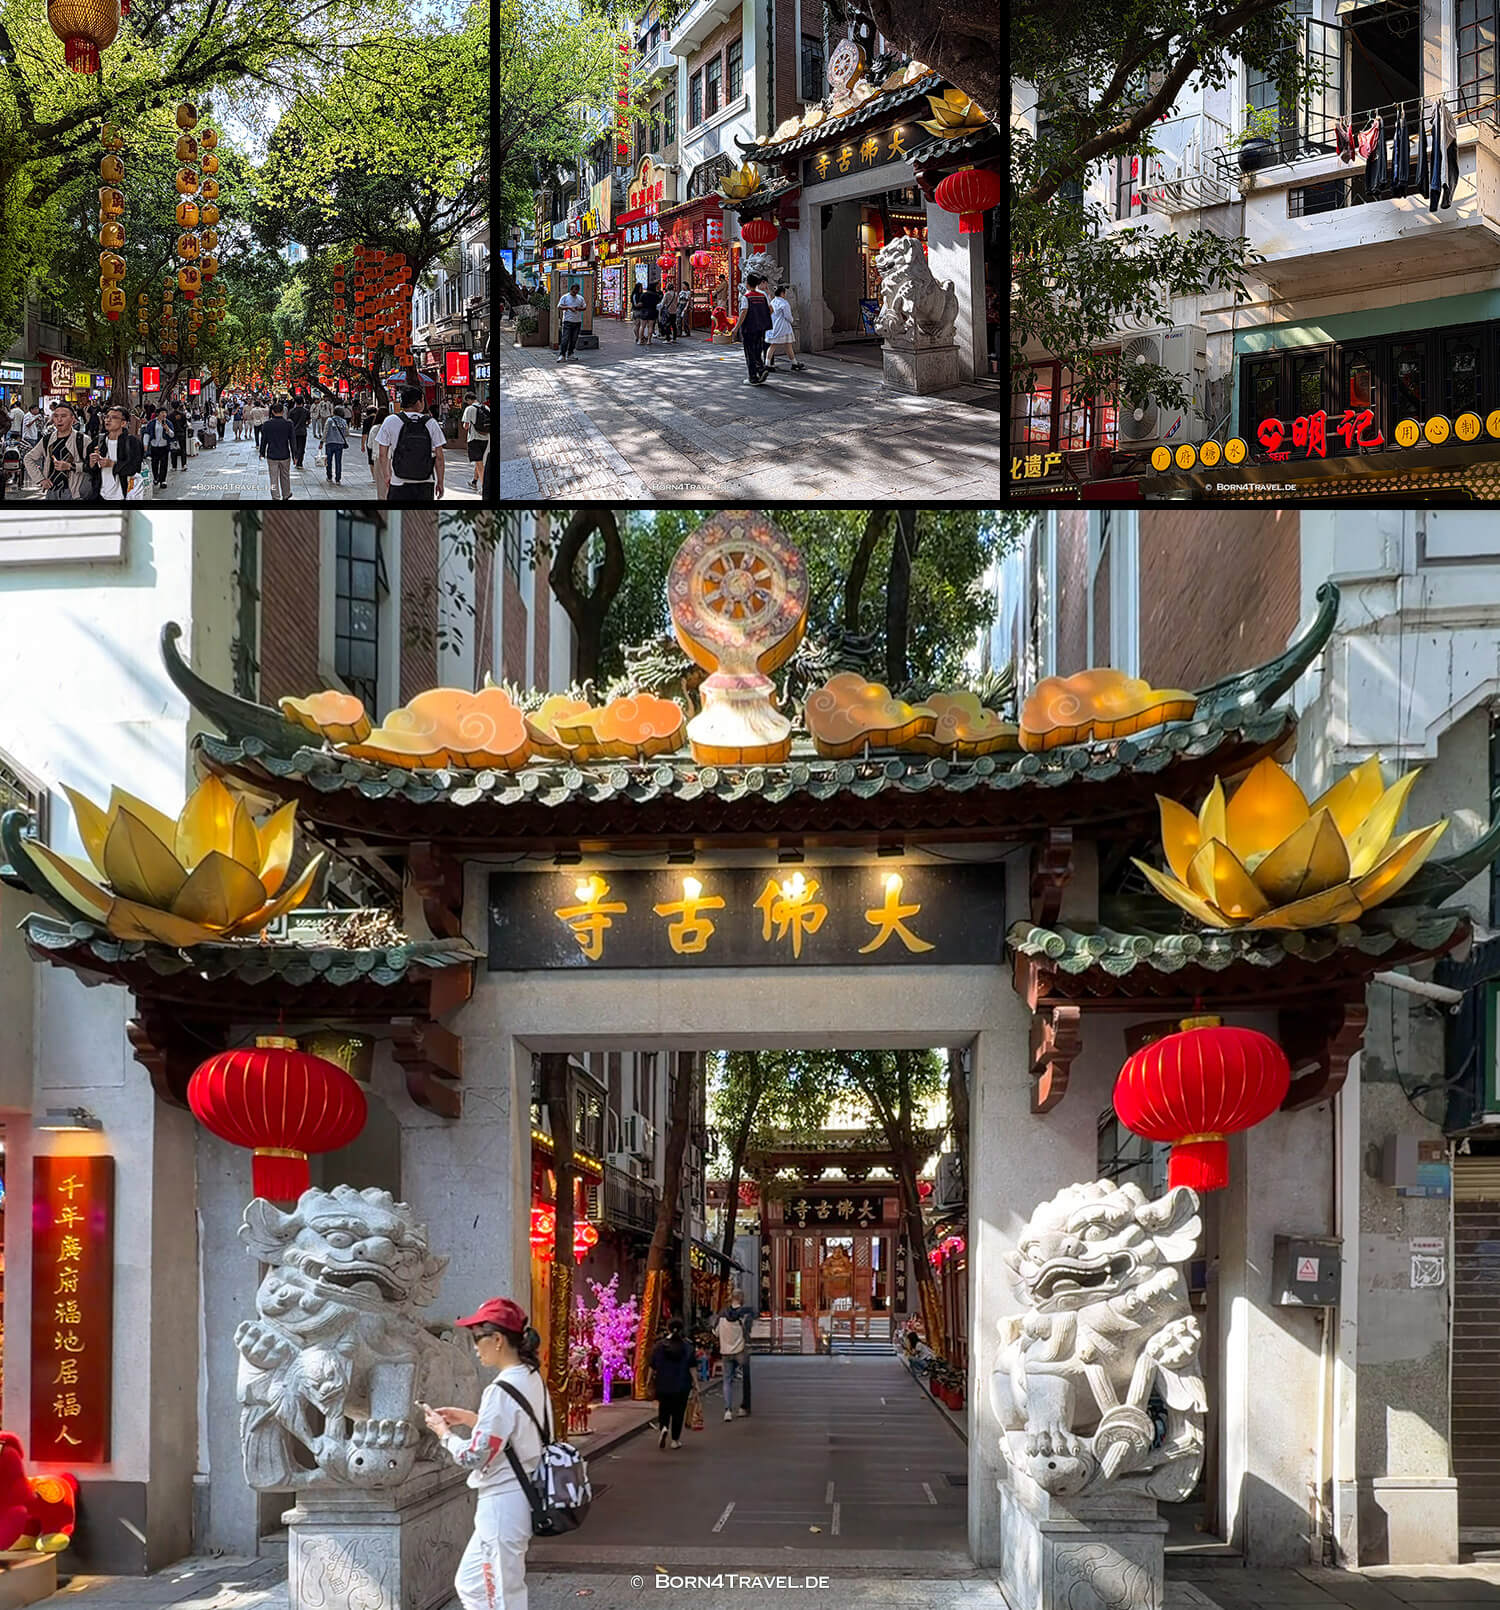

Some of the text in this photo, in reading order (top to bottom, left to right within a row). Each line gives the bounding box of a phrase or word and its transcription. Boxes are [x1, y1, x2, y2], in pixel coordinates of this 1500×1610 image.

[815, 130, 907, 180] 大佛古寺
[1292, 409, 1384, 458] 明记
[554, 872, 936, 961] 大佛古寺
[792, 1198, 877, 1221] 大佛古寺
